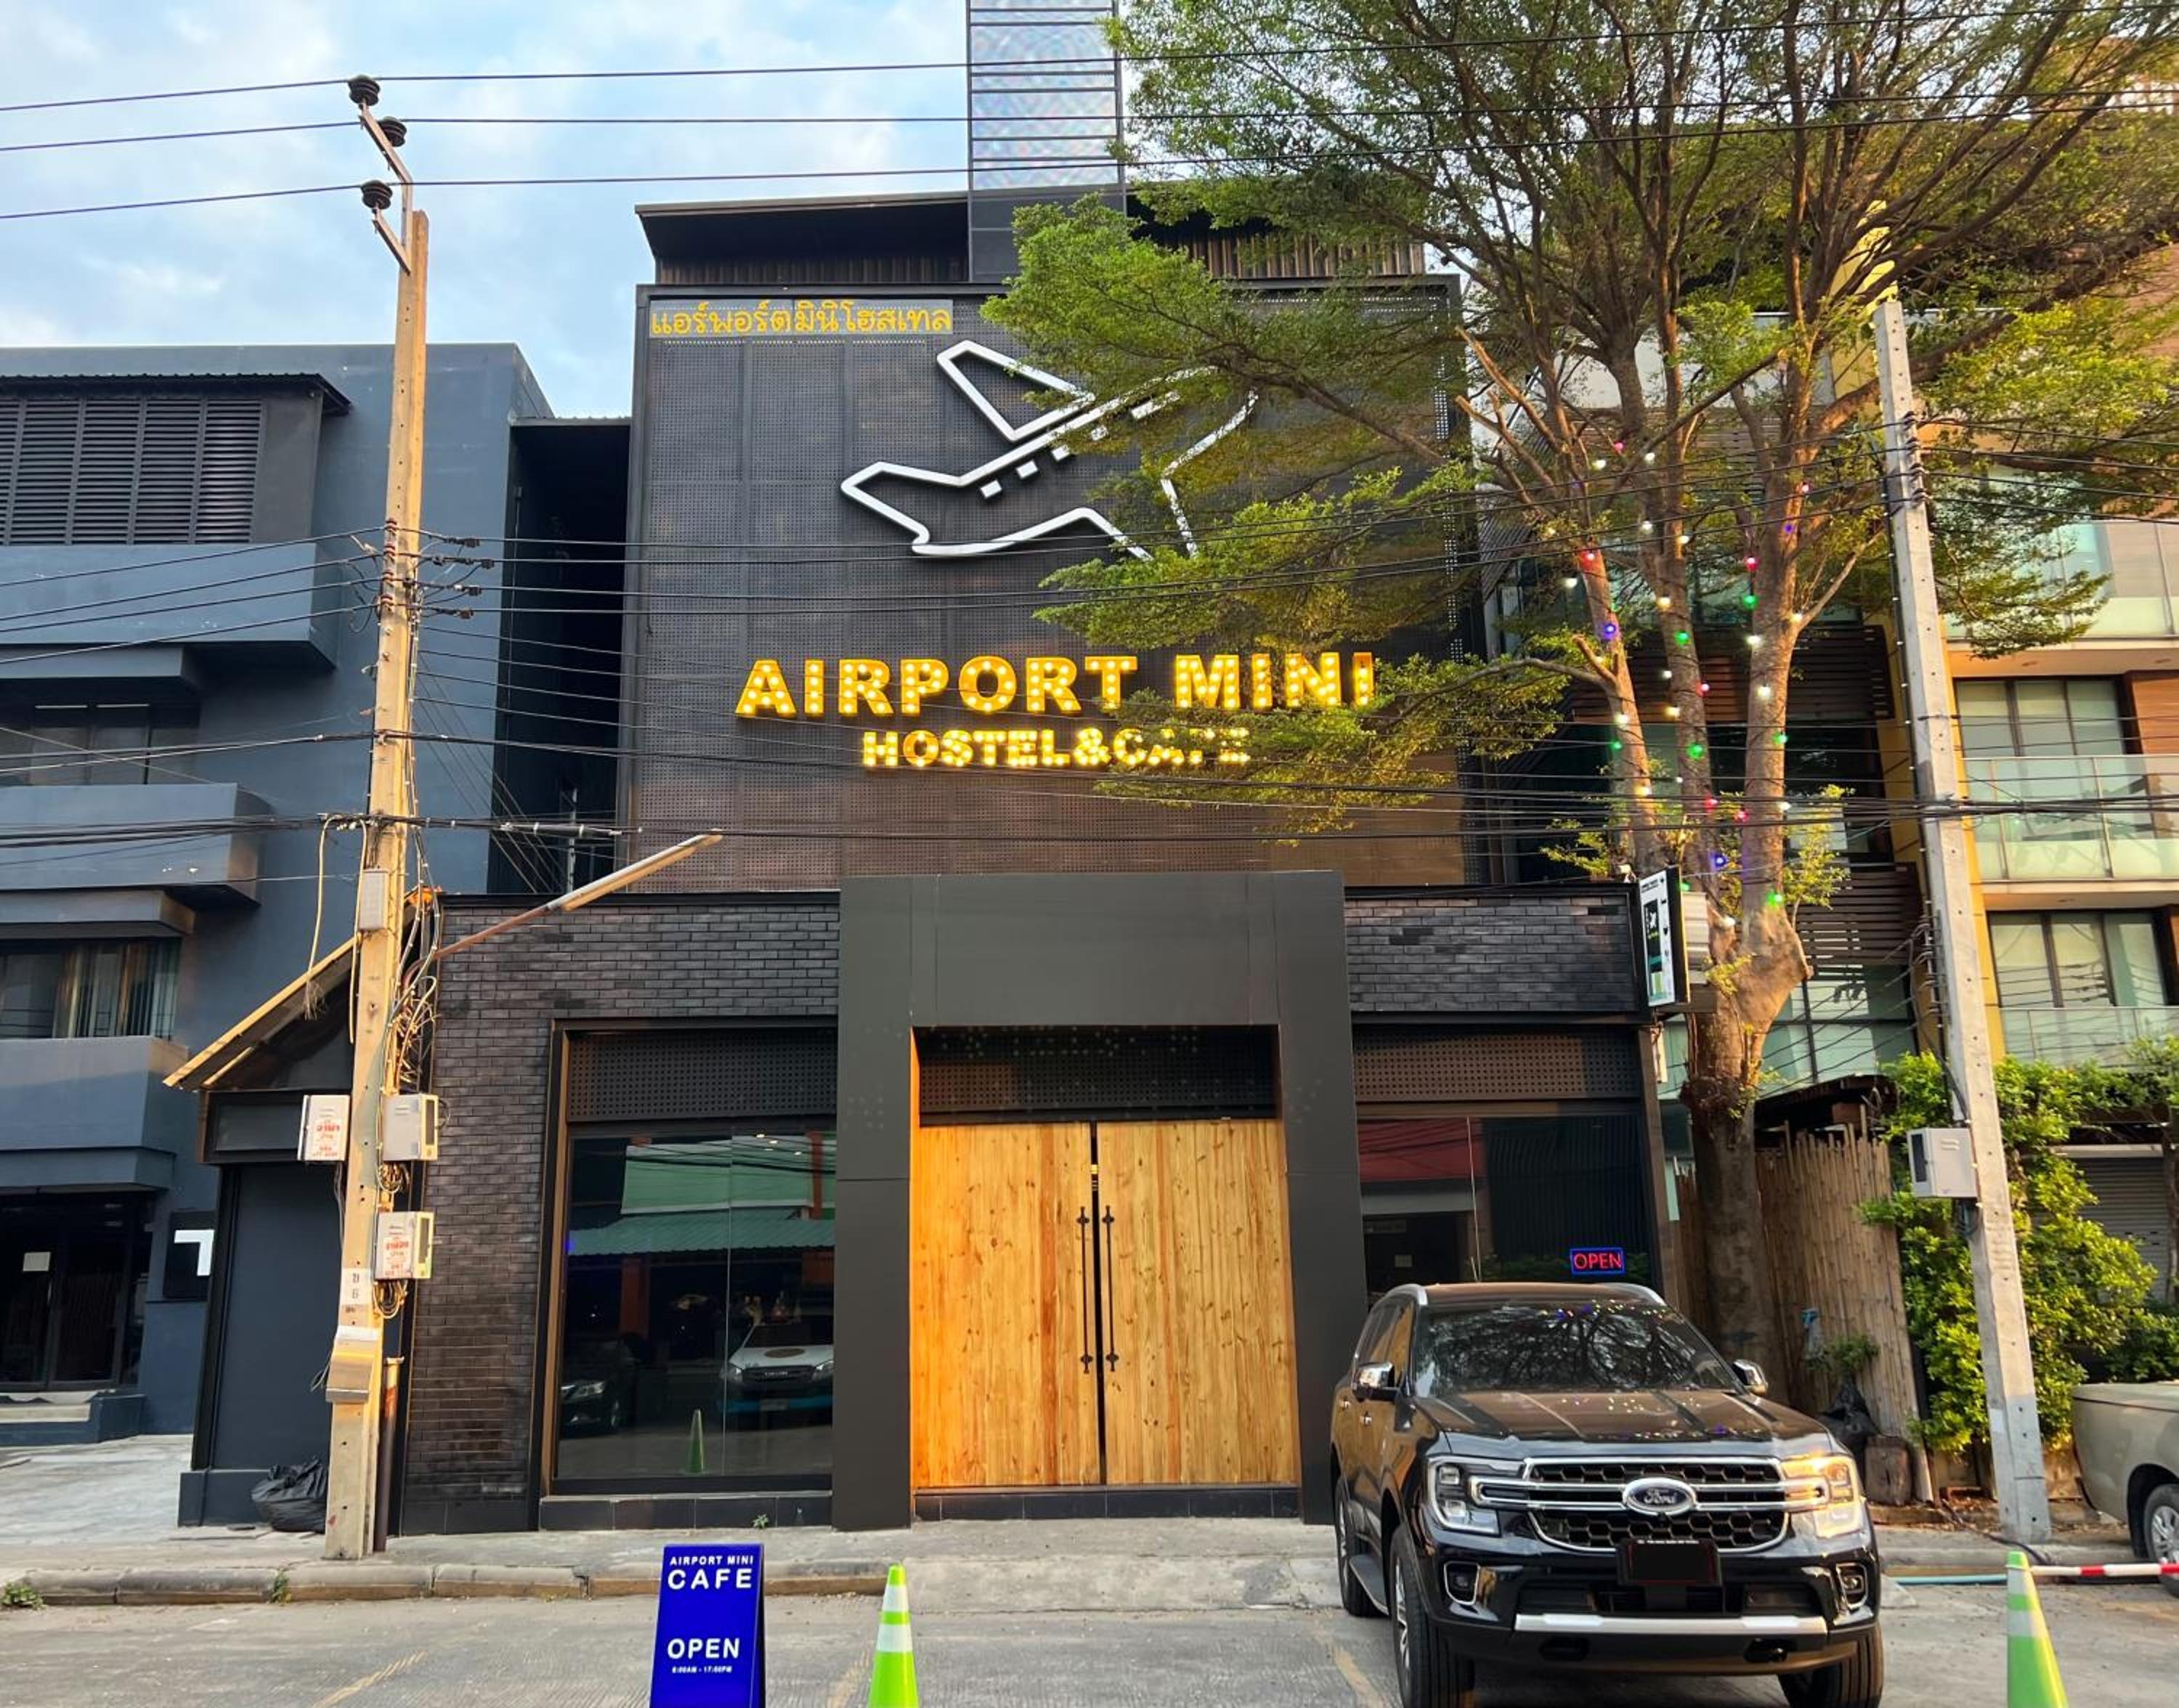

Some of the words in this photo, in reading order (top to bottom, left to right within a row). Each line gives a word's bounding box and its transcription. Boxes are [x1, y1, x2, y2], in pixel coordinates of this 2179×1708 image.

[651, 300, 951, 334] แอร์พอร์ตมินิโฮสเทล
[734, 655, 1137, 715] AIRPORT
[1175, 651, 1375, 709] MINI
[1573, 1253, 1622, 1269] OPEN
[1643, 1488, 1678, 1504] Ford
[669, 1556, 723, 1566] AIRPORT
[727, 1555, 754, 1565] MINI
[668, 1568, 752, 1590] CAFE
[667, 1638, 740, 1659] OPEN
